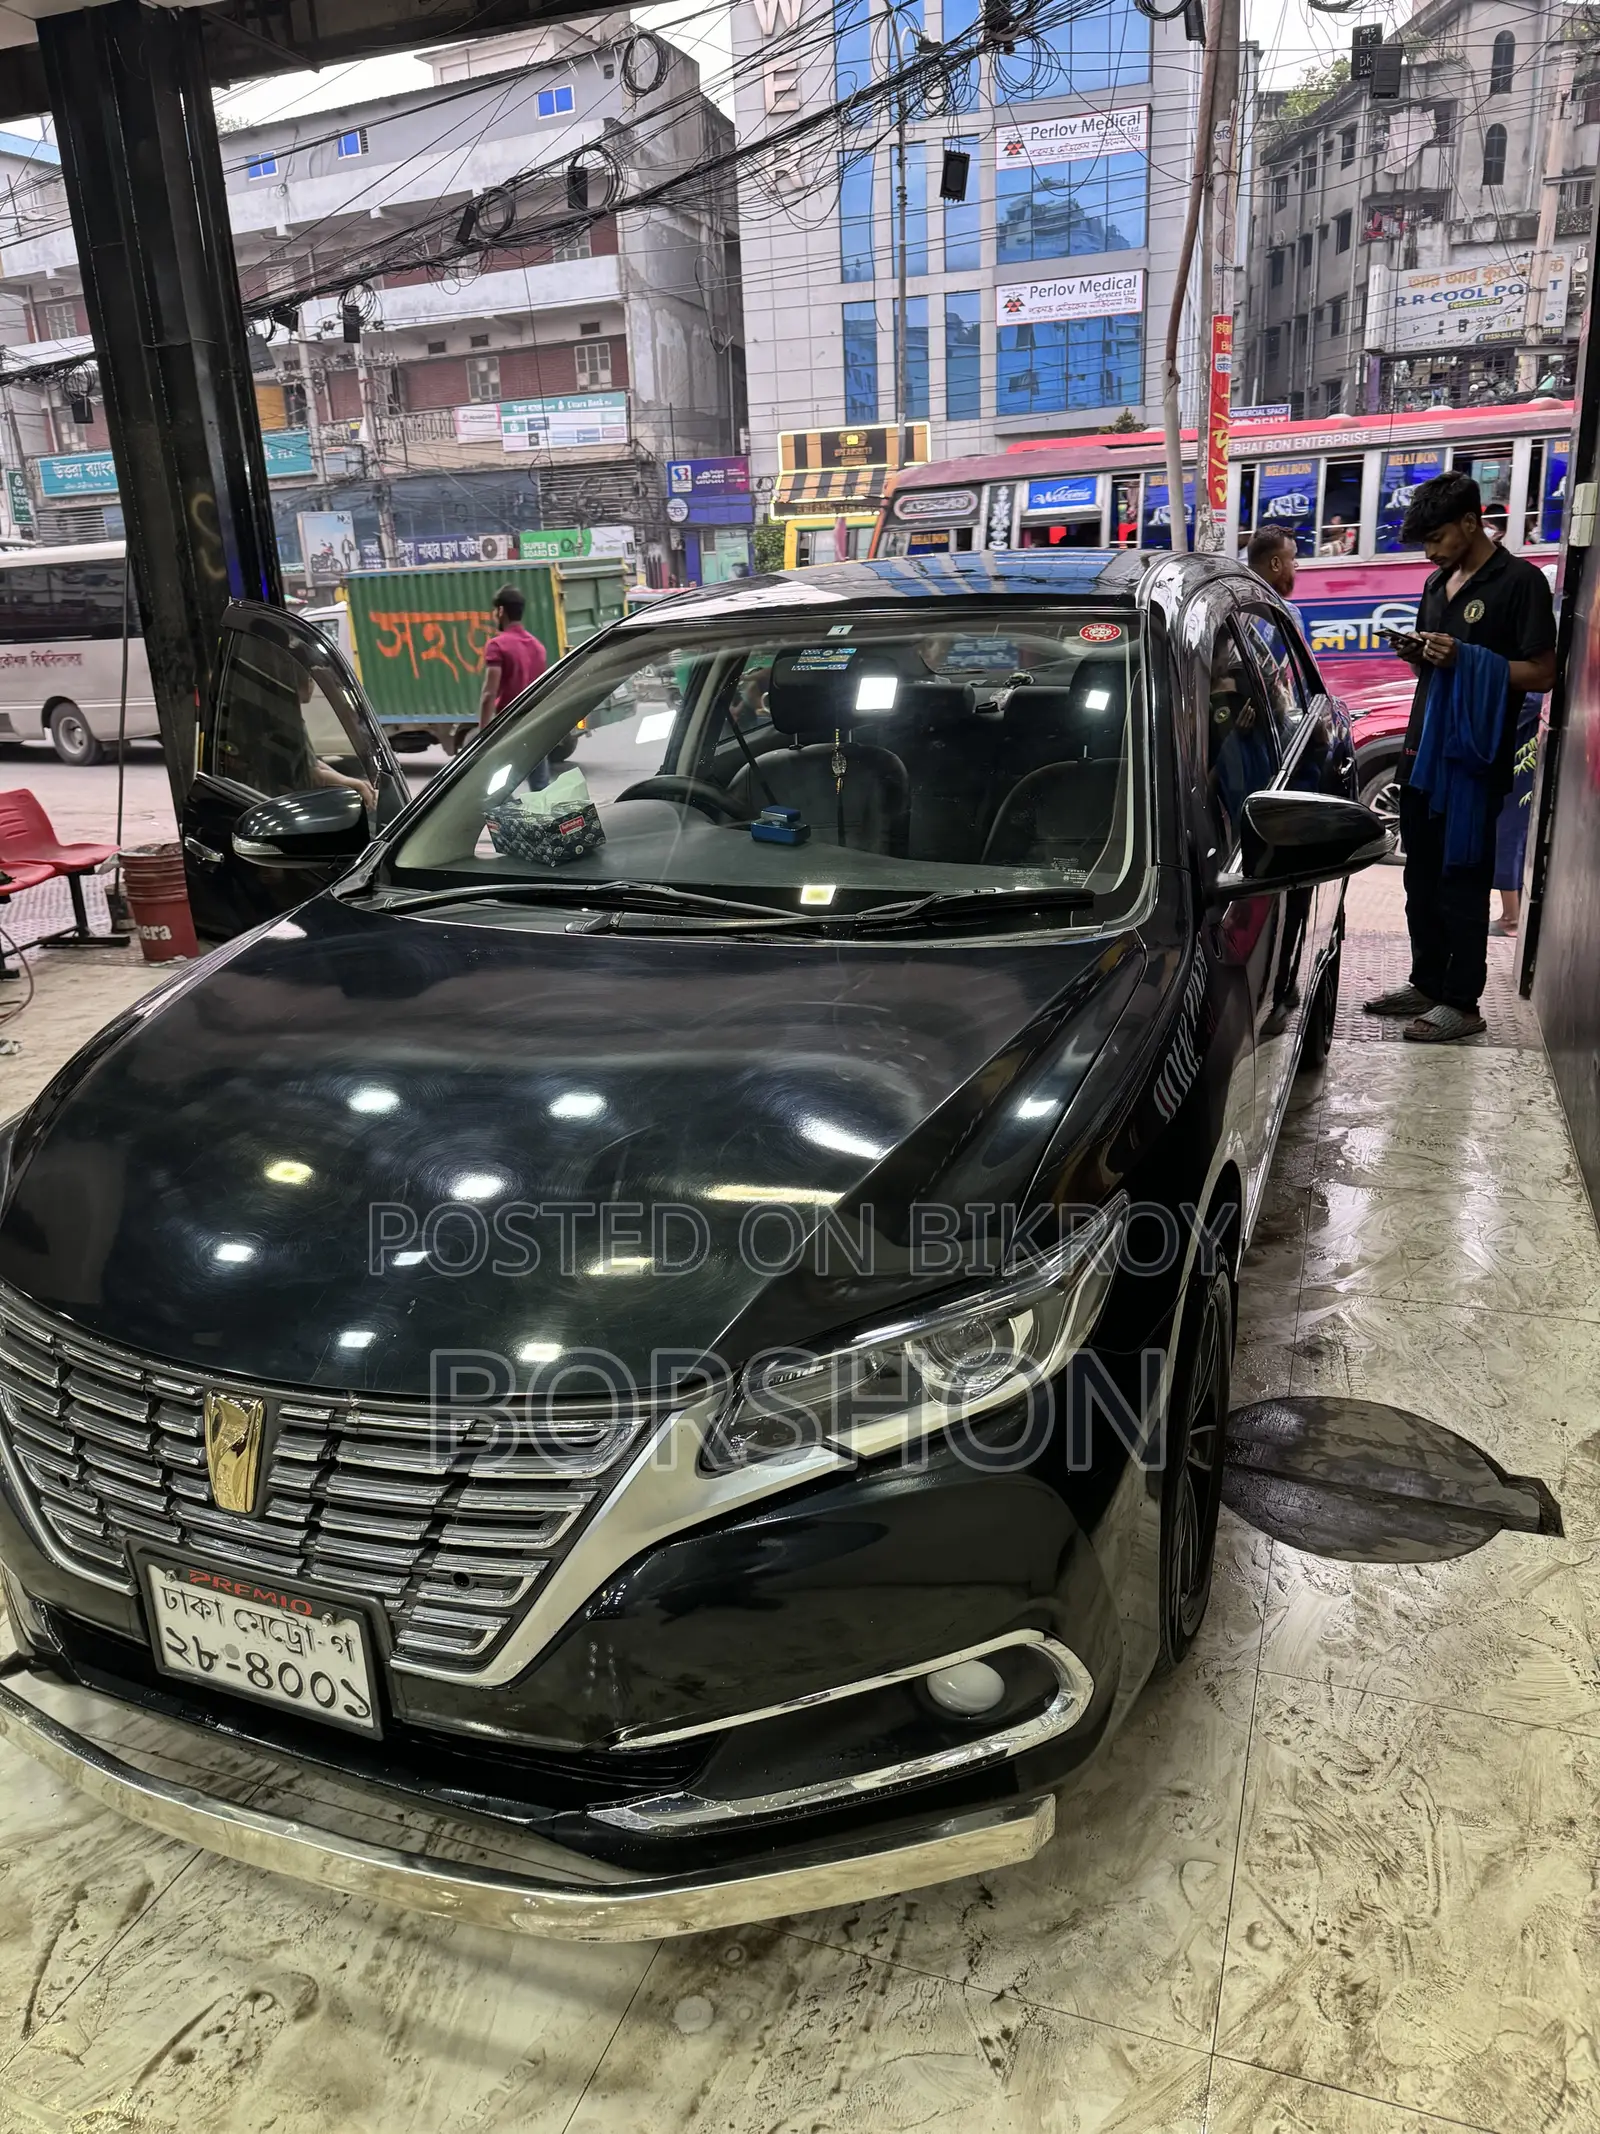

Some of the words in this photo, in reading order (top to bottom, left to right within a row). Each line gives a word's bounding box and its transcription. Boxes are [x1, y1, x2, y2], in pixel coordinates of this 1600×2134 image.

[1030, 123, 1077, 141] Perlov
[1081, 110, 1141, 134] Medical
[1029, 283, 1075, 299] Perlov
[1079, 275, 1137, 294] Medical
[1094, 290, 1122, 300] Services
[1412, 294, 1425, 306] R
[1430, 288, 1488, 303] COOL
[1494, 279, 1562, 297] POT
[1229, 409, 1266, 418] OMMERCIAL
[1265, 439, 1292, 450] BON
[1294, 431, 1370, 449] ENTERPRISE
[160, 1586, 225, 1627] ঢাকা
[189, 1569, 313, 1617] PREMIO
[165, 1627, 371, 1719] ২৮-৪০০১
